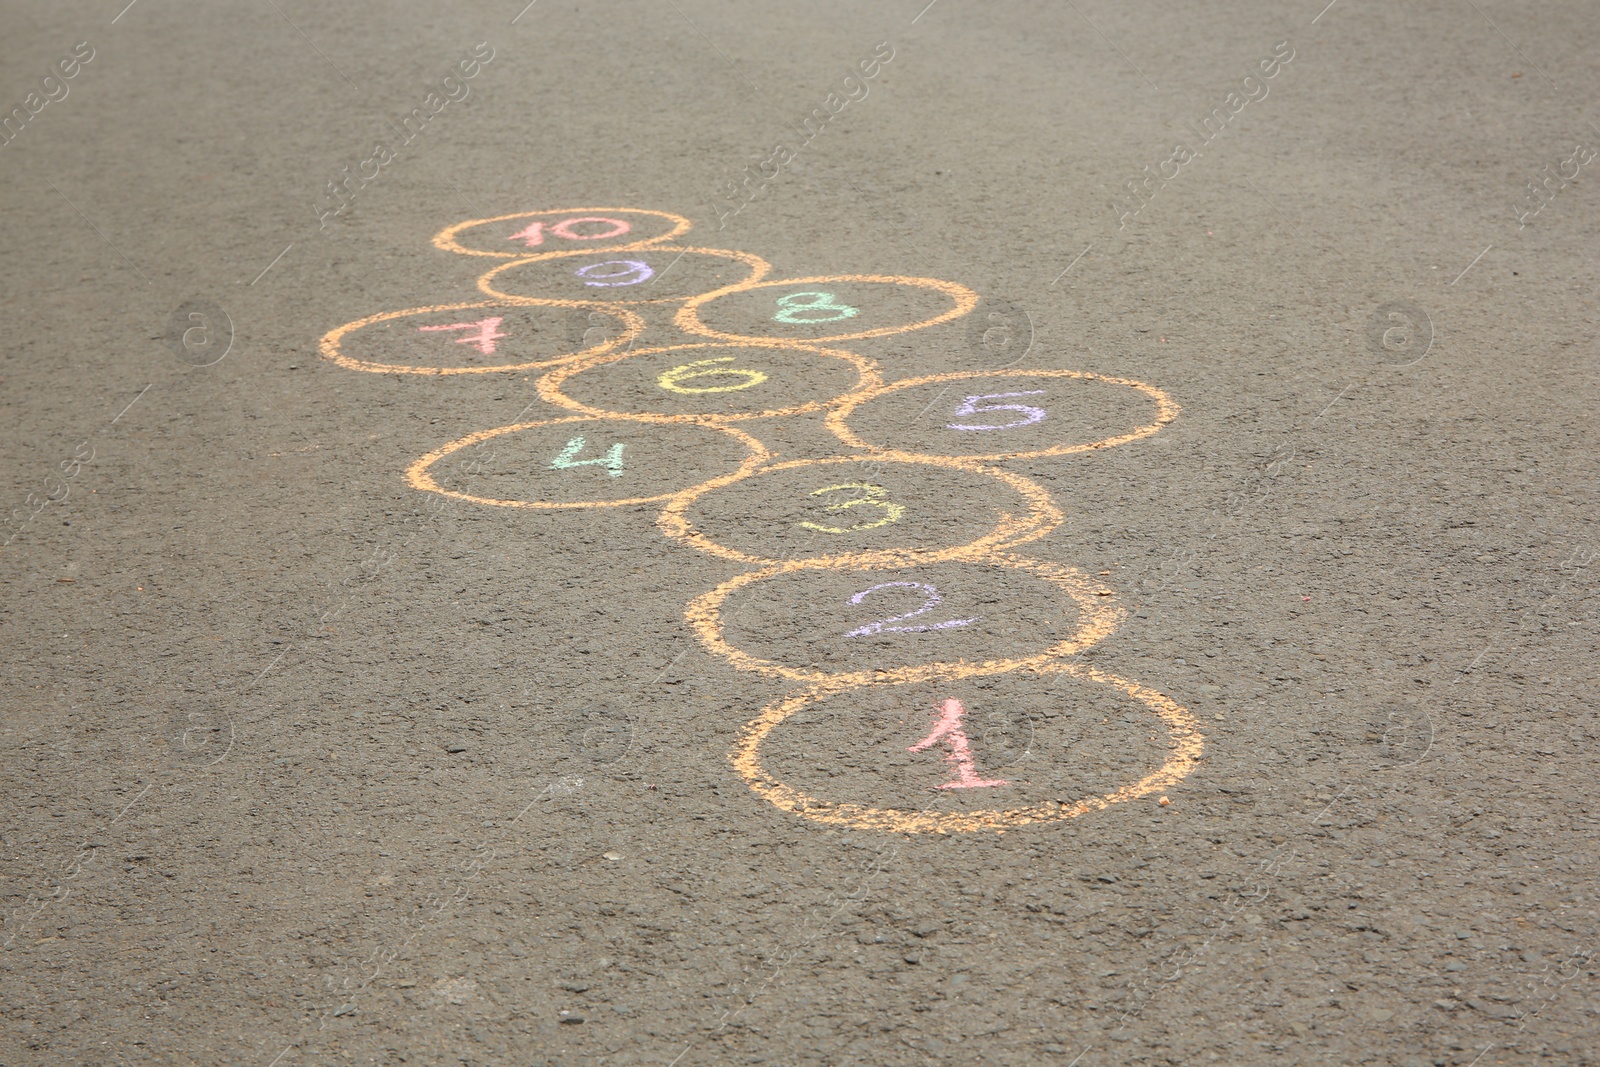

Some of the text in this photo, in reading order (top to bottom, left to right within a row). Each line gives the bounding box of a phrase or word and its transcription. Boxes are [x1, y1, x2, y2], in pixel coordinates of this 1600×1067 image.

[508, 217, 631, 246] 10
[575, 260, 655, 287] 9
[773, 292, 859, 323] 8
[417, 316, 511, 354] 7
[656, 357, 769, 394] 6
[946, 389, 1047, 431] 5
[549, 435, 626, 477] 4
[799, 482, 906, 533] 3
[844, 582, 983, 638] 2
[906, 697, 1009, 791] 1
